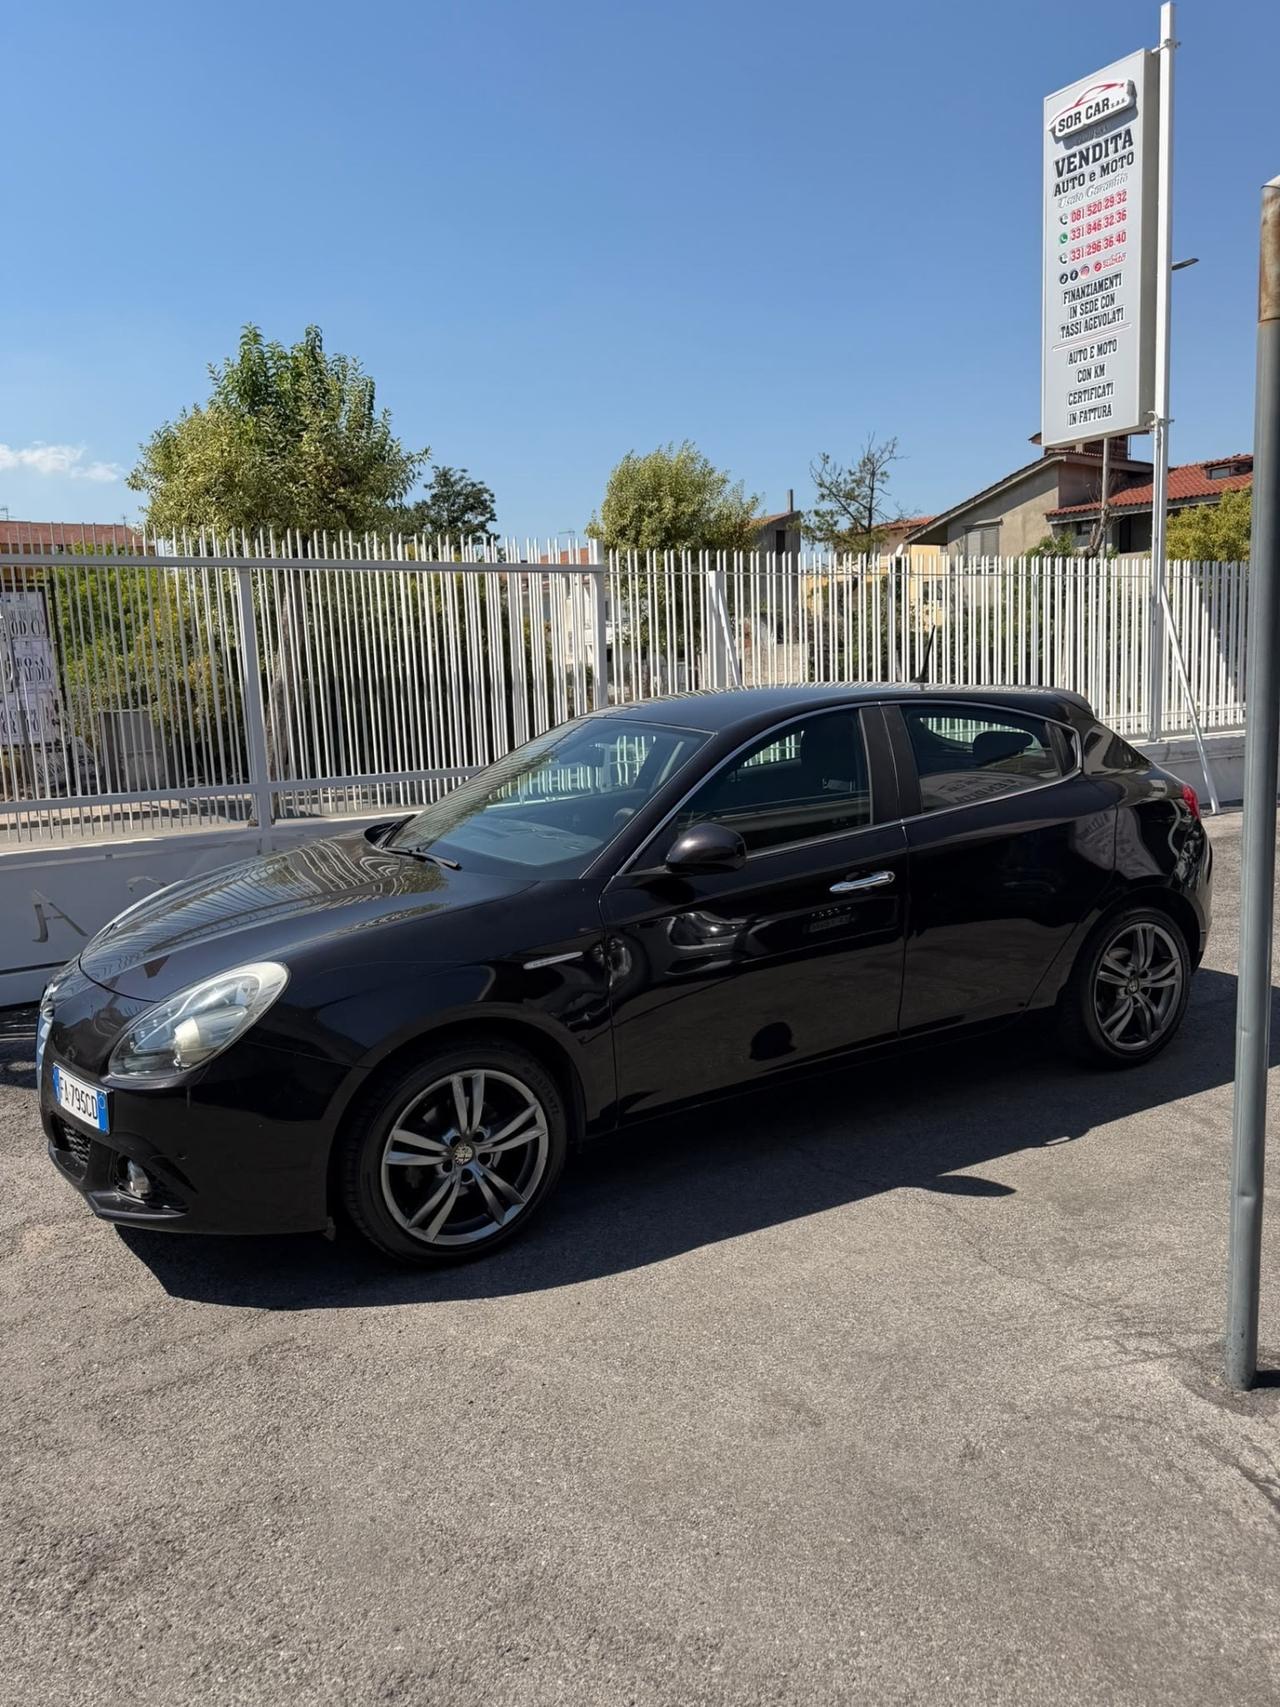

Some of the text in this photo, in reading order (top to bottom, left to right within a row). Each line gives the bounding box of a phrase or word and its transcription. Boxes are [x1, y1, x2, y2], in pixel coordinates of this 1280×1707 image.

[1058, 111, 1082, 133] SOR
[1085, 97, 1110, 120] CAR
[1054, 128, 1134, 178] VENDITA
[1054, 172, 1086, 198] AUTO
[1099, 151, 1134, 178] MOTO
[1063, 272, 1122, 305] FINANZIAMENTI
[1069, 292, 1116, 320] IN SEDE CON
[1061, 307, 1124, 339] TASSI AGEVOLATI
[1068, 338, 1118, 365] AUTO E MOTO
[1077, 363, 1106, 383] CON KM
[1068, 382, 1114, 406] CERTIFICATI
[1069, 403, 1112, 426] IN FATTURA
